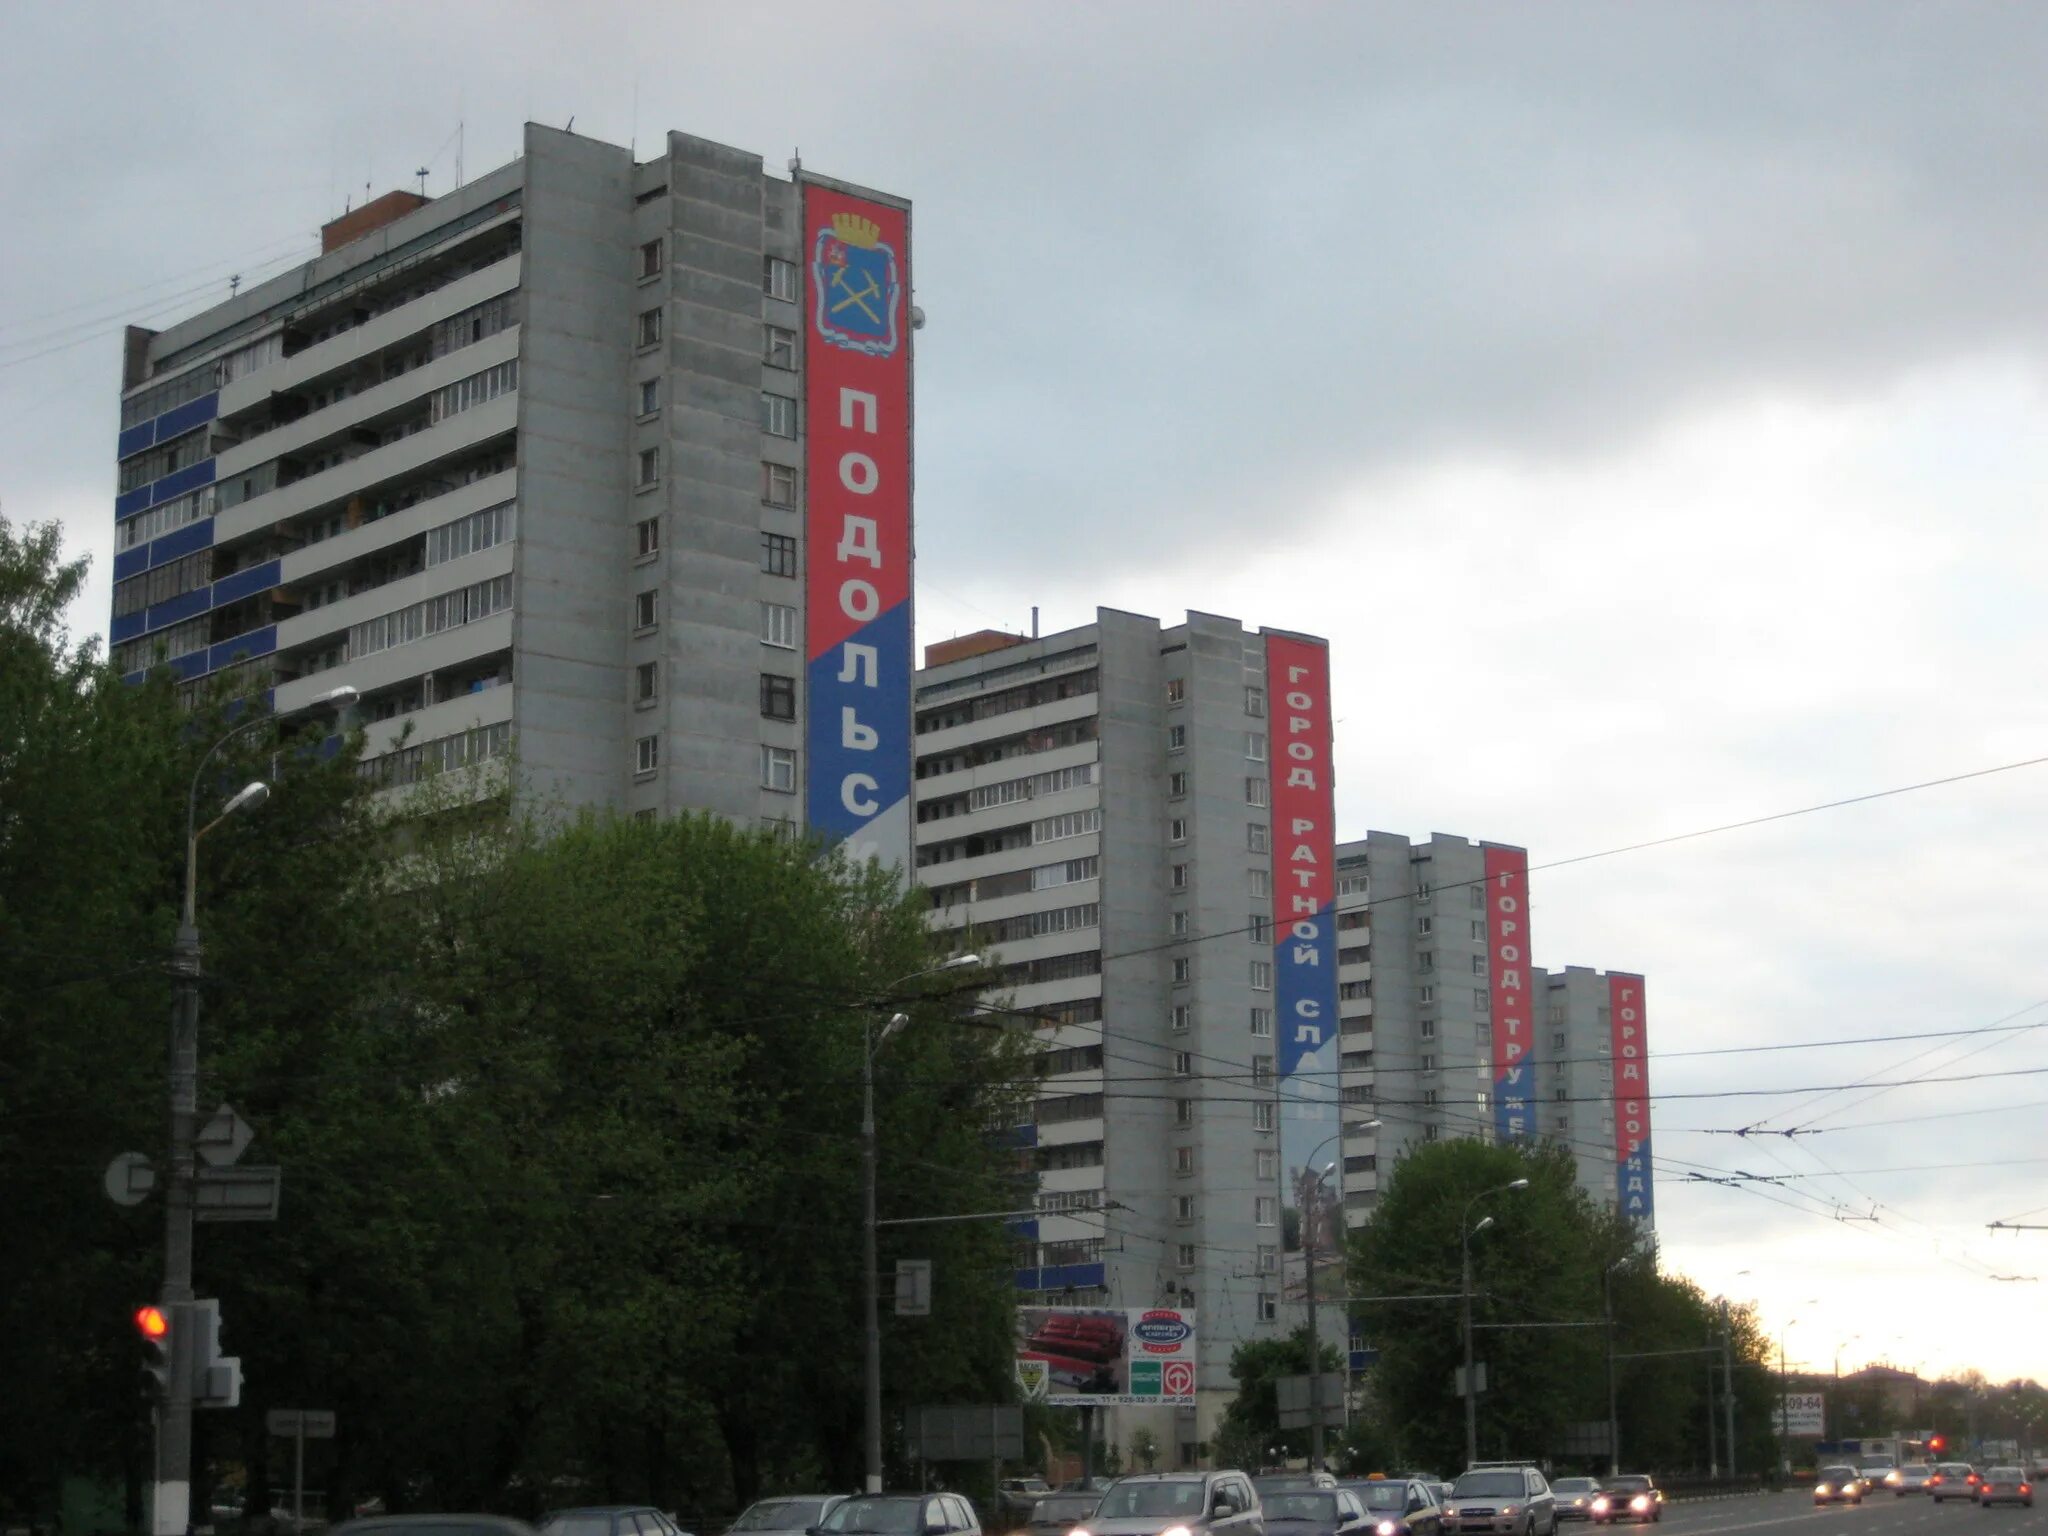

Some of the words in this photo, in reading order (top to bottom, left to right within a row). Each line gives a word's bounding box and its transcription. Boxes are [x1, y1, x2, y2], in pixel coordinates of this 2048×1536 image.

[1286, 665, 1316, 791] ГОРОД
[1291, 818, 1320, 967] РАТНОЙ
[1621, 988, 1639, 1080] ГОРОД
